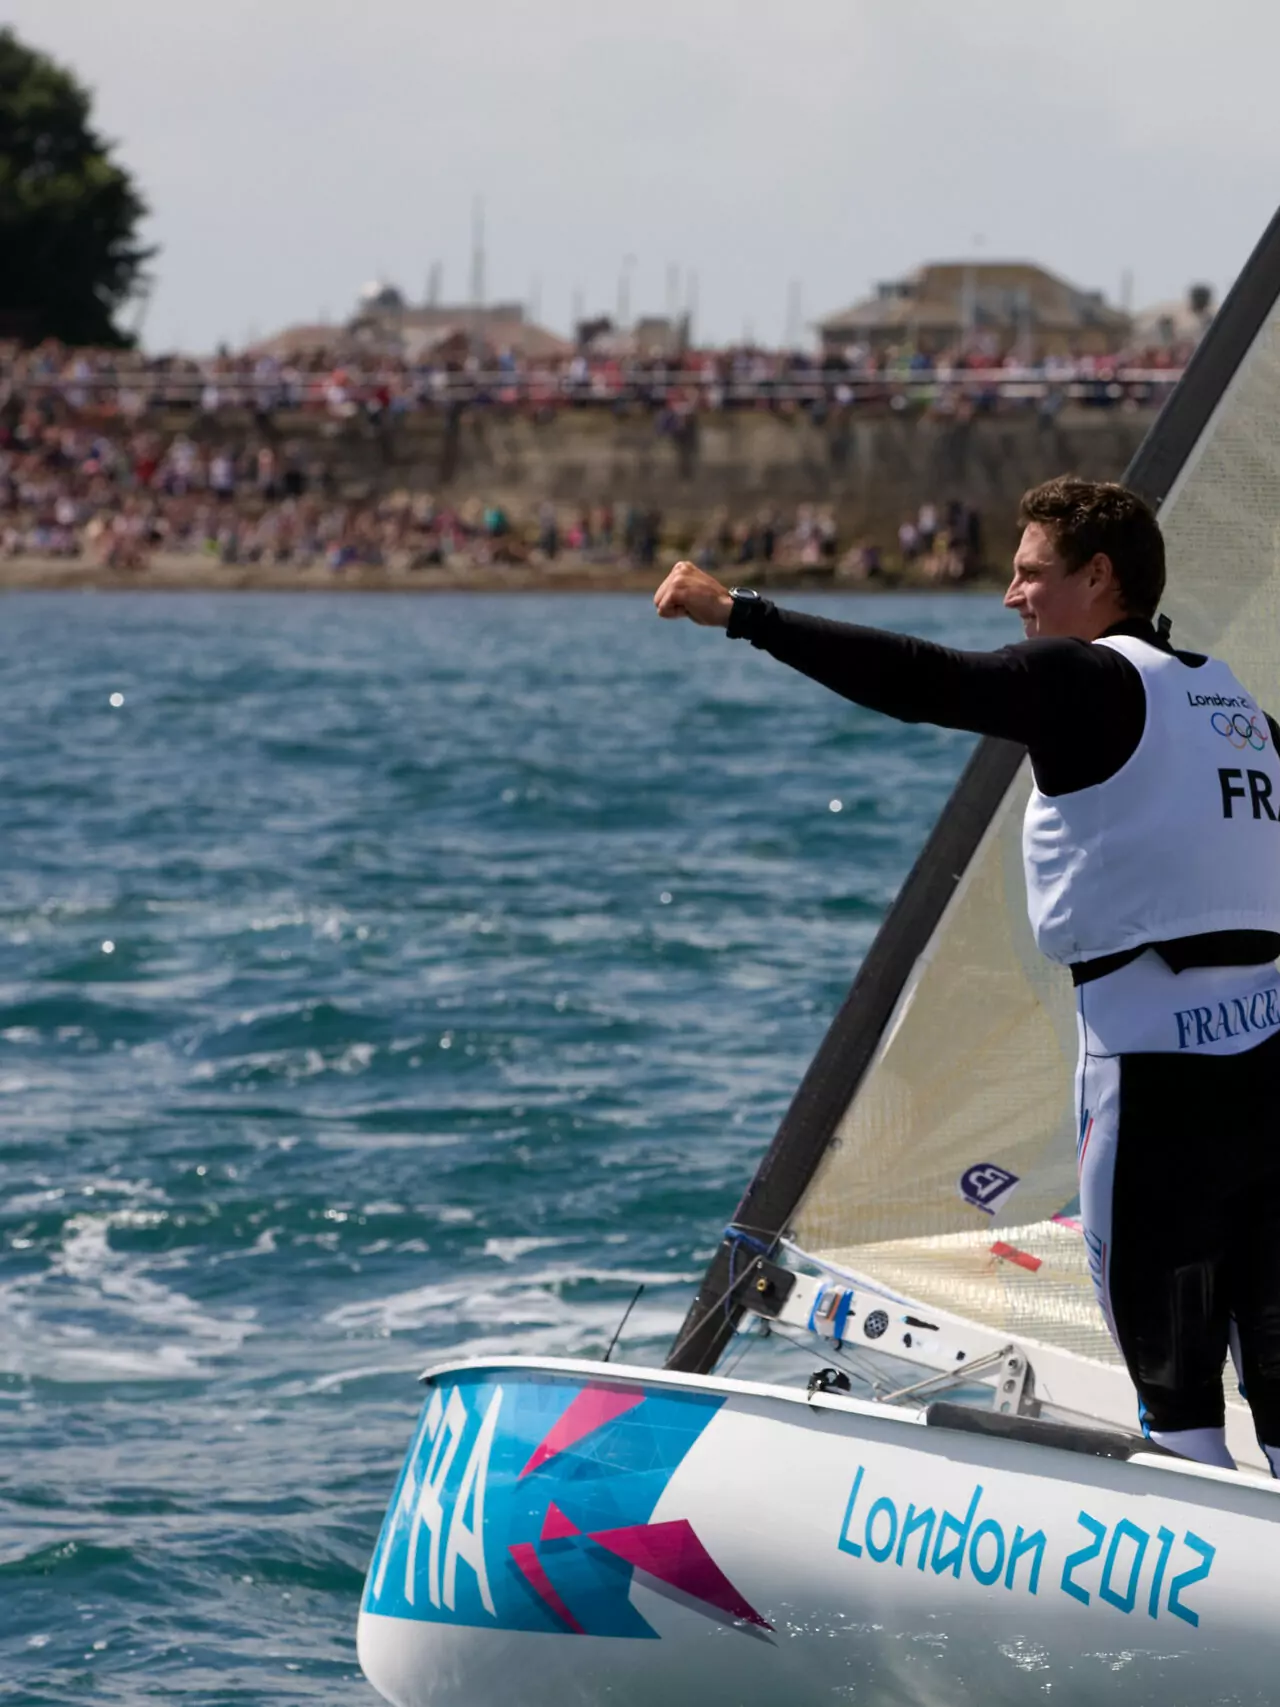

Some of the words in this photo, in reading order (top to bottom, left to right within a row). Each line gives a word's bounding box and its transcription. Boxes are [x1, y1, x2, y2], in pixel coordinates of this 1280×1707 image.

[1186, 690, 1240, 708] London
[374, 1384, 504, 1618] FRA
[837, 1465, 1048, 1596] London
[1060, 1510, 1217, 1629] 2012
